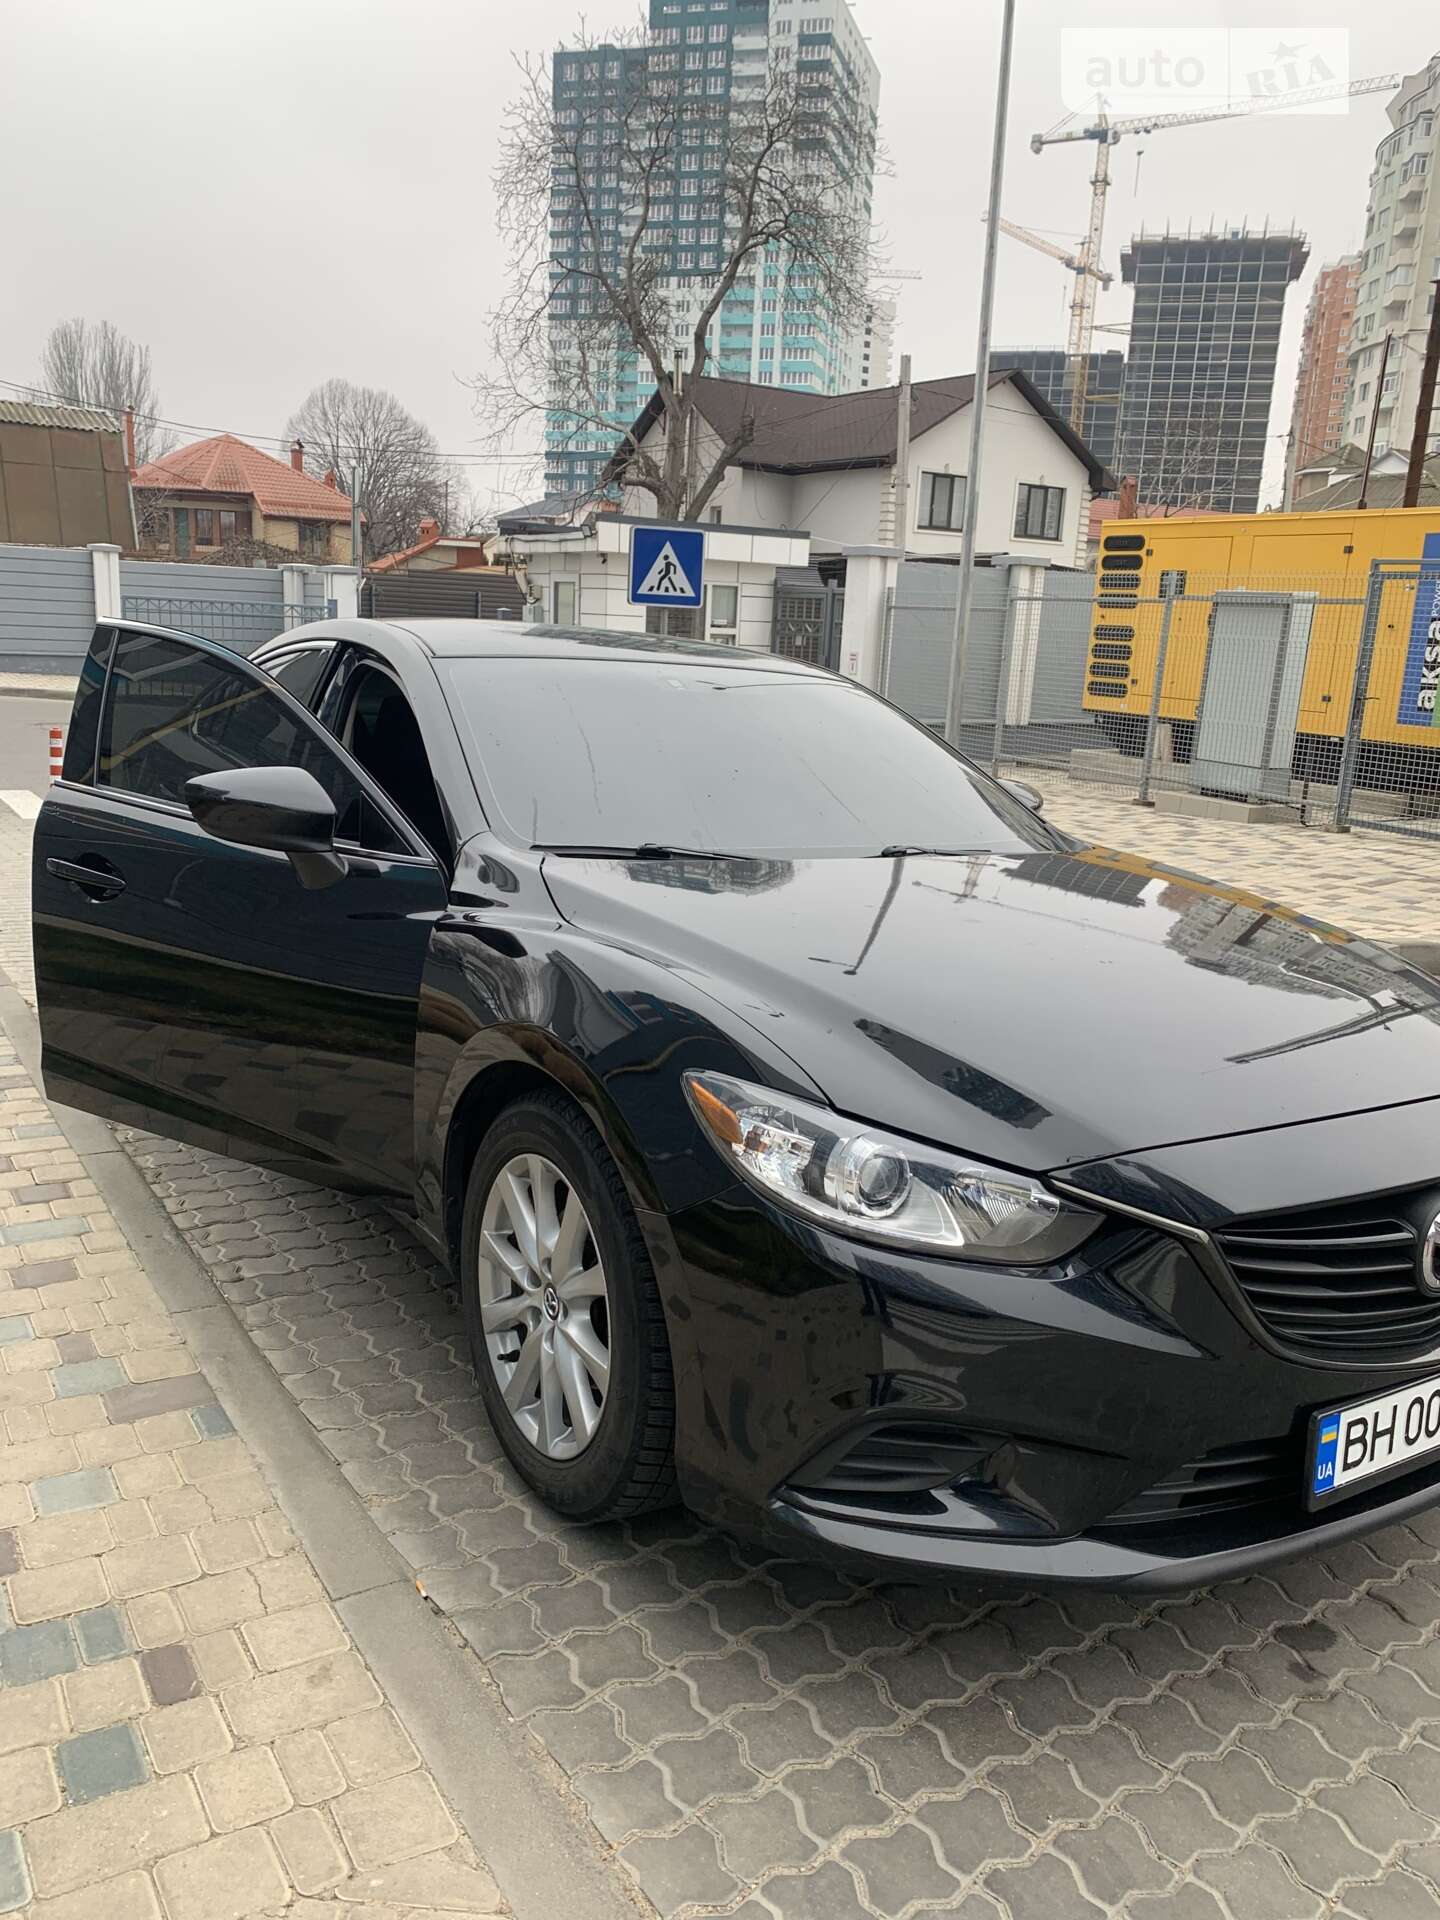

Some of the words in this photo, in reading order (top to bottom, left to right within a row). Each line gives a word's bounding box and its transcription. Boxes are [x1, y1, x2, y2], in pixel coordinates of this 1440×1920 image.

[1417, 620, 1440, 709] aksa
[1317, 1461, 1333, 1480] UA
[1342, 1404, 1398, 1472] BH
